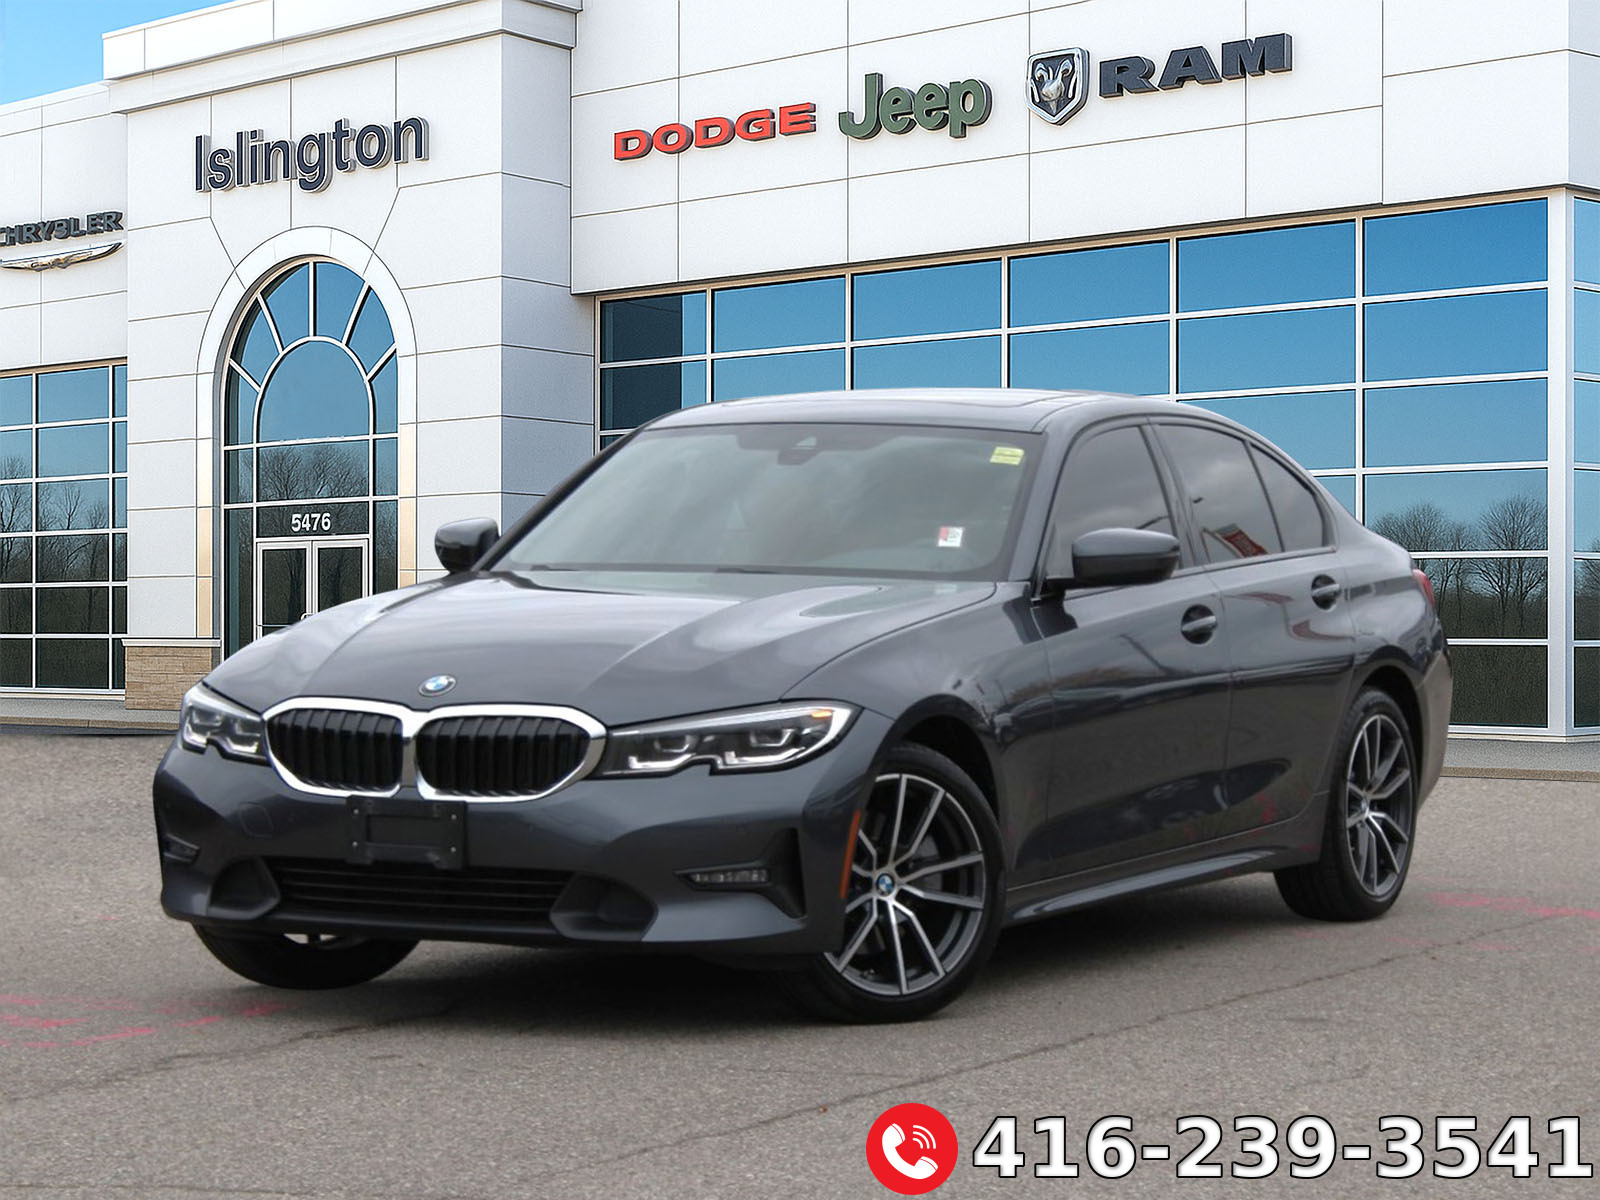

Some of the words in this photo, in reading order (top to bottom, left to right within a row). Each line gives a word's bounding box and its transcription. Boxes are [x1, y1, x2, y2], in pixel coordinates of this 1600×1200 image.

[1099, 32, 1292, 98] RAM
[614, 102, 816, 161] DODGE
[839, 73, 992, 140] Jeep
[195, 117, 429, 193] Islington
[291, 512, 331, 532] 5476
